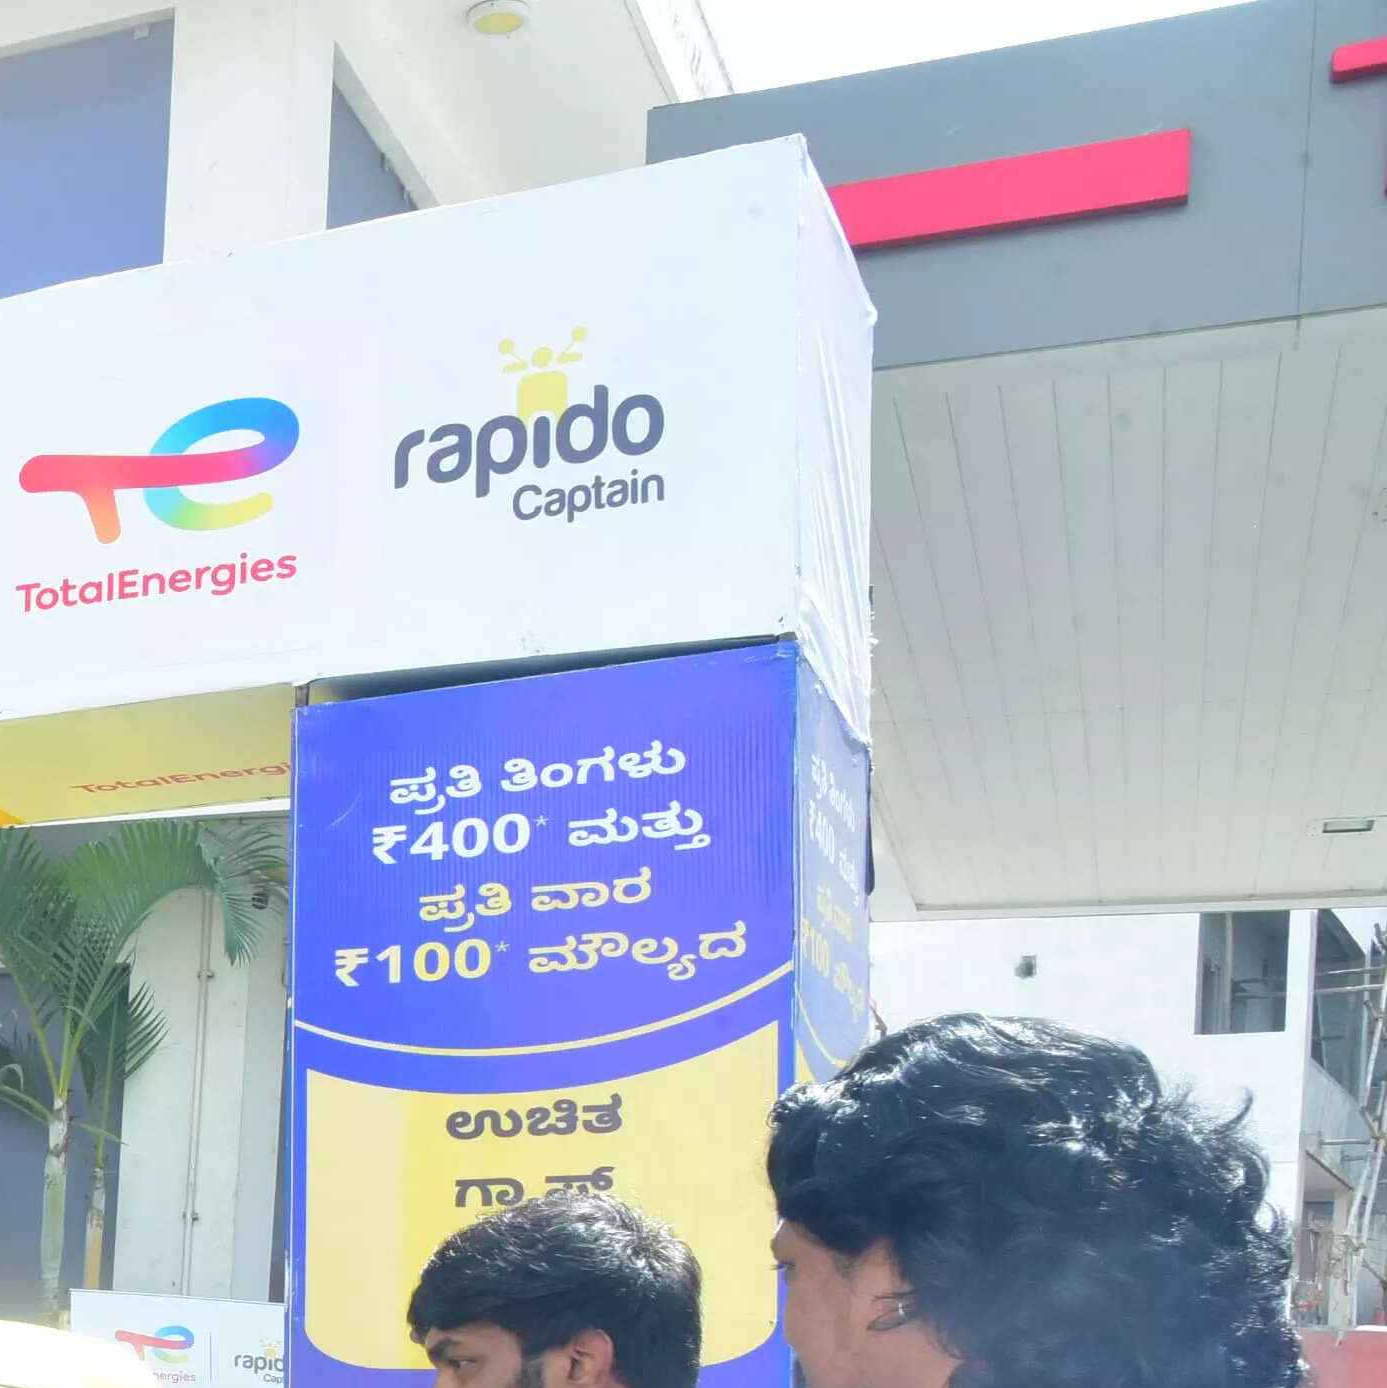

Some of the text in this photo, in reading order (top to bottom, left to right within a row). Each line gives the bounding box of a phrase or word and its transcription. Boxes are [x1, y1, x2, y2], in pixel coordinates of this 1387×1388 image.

[394, 384, 664, 498] rapido
[512, 471, 664, 523] Captain
[16, 552, 297, 612] TotalEnergies
[389, 739, 687, 815] ಪ್ರತಿ ತಿಂಗಳು
[568, 800, 711, 851] ಮತ್ತು
[419, 866, 652, 933] ಪ್ರತಿ ವಾರ
[529, 920, 748, 982] ಮೌಲ್ಯದ
[445, 1092, 623, 1140] ಉಚಿತ
